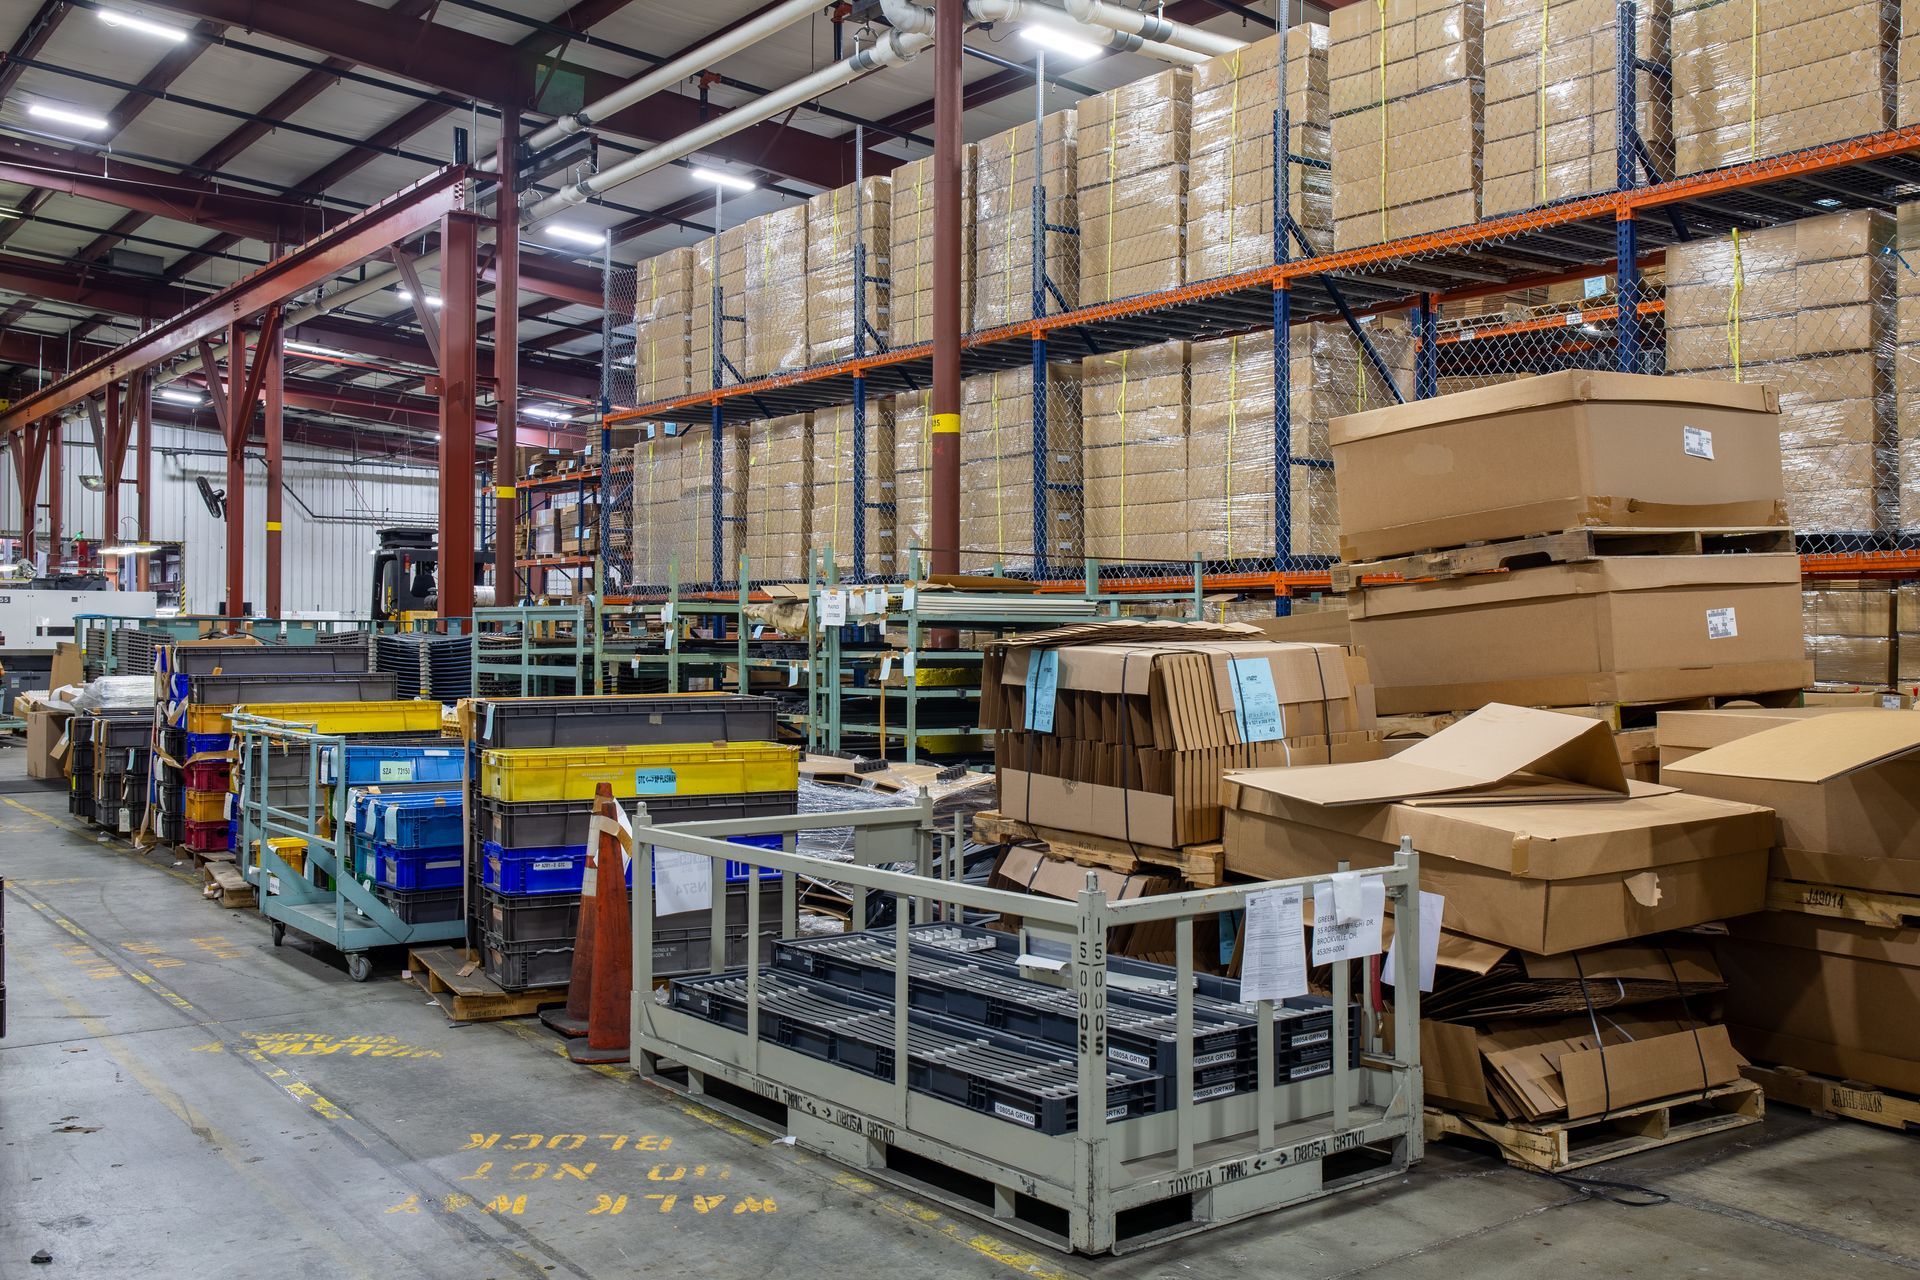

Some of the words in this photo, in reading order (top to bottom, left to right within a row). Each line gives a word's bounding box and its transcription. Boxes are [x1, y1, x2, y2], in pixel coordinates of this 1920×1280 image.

[1129, 1055, 1149, 1066] GRTKO
[1215, 1051, 1235, 1061] GRTKO
[1214, 1084, 1234, 1094] GRTKO
[751, 1077, 779, 1101] TOYOTA
[836, 1109, 862, 1133] 0805A
[867, 1121, 895, 1145] GRTKO
[1016, 1110, 1034, 1123] GRTKO
[458, 1132, 674, 1151] BLOCK
[460, 1161, 598, 1182] NOT
[1168, 1170, 1212, 1197] TOYOTA
[1219, 1160, 1248, 1182] TMMC
[1294, 1140, 1327, 1163] 0805A
[1333, 1130, 1365, 1152] GRTKO
